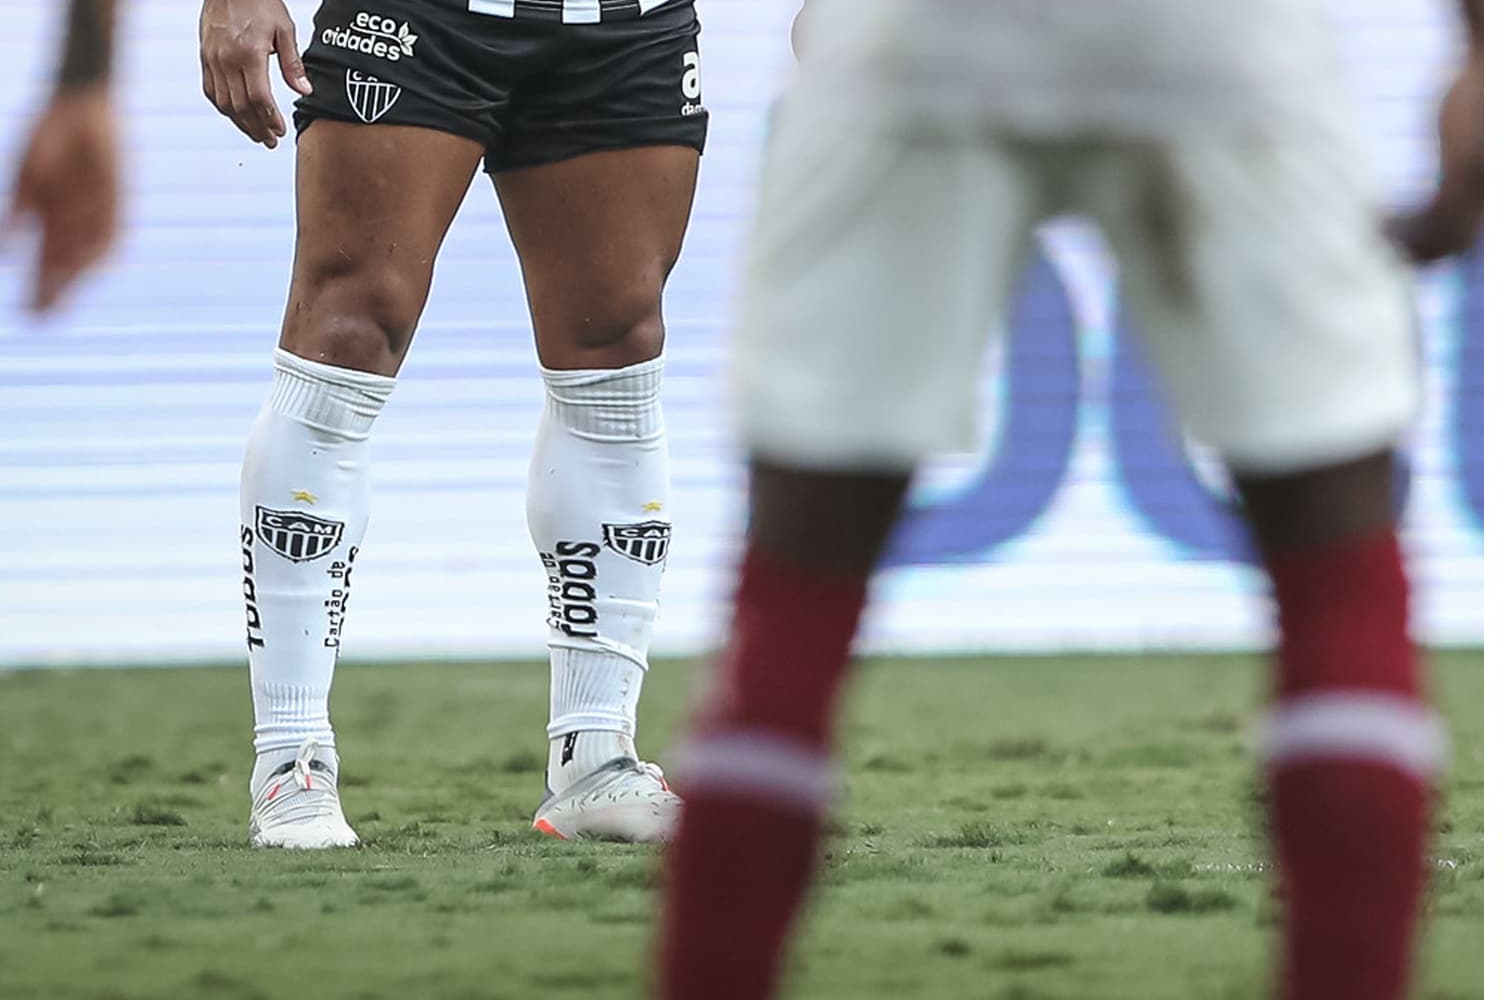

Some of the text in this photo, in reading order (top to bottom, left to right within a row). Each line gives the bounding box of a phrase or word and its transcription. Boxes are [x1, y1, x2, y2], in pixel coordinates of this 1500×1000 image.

[356, 12, 396, 34] eco
[265, 516, 332, 534] CAM
[324, 561, 345, 648] Cartão de
[556, 541, 600, 637] TODOS
